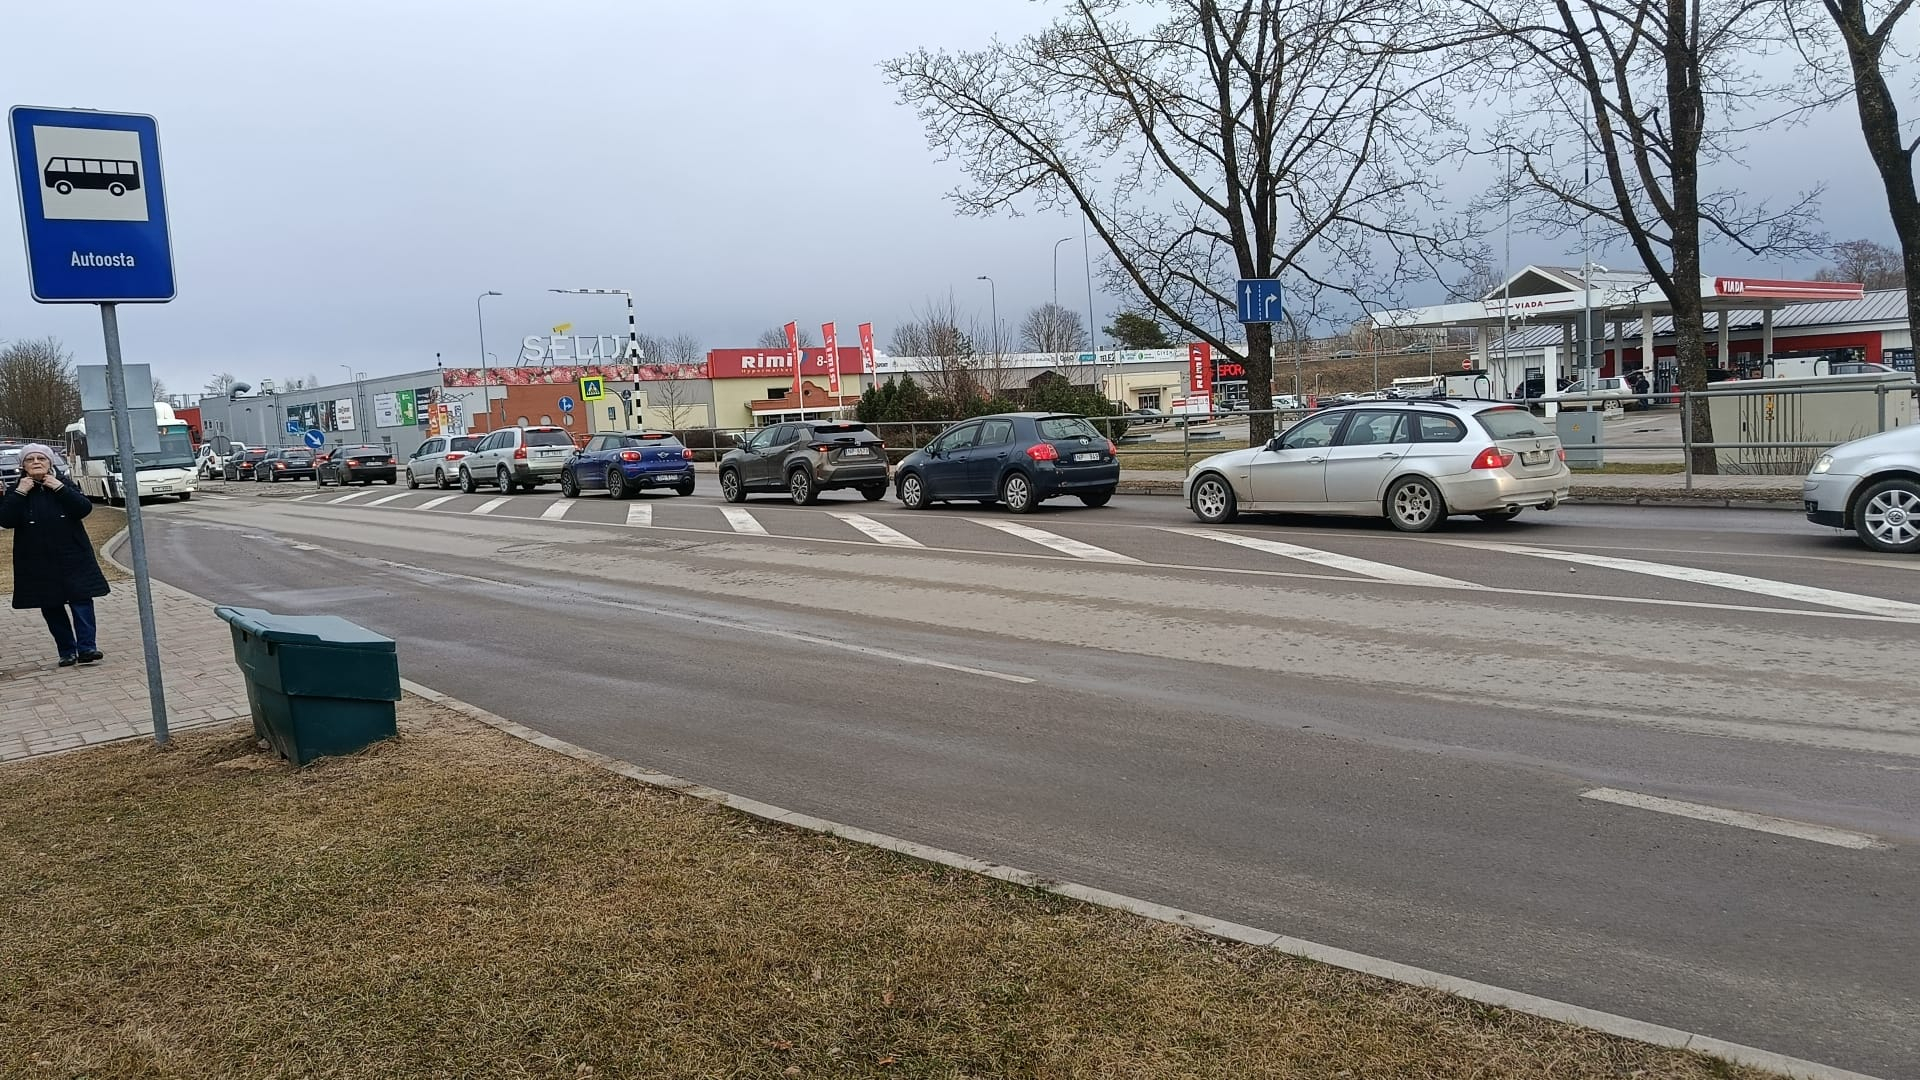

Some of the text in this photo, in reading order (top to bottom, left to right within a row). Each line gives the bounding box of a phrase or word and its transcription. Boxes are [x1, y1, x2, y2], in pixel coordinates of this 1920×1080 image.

[71, 251, 135, 267] Autoosta
[1722, 280, 1745, 293] VIADA
[1514, 301, 1544, 309] VIADA
